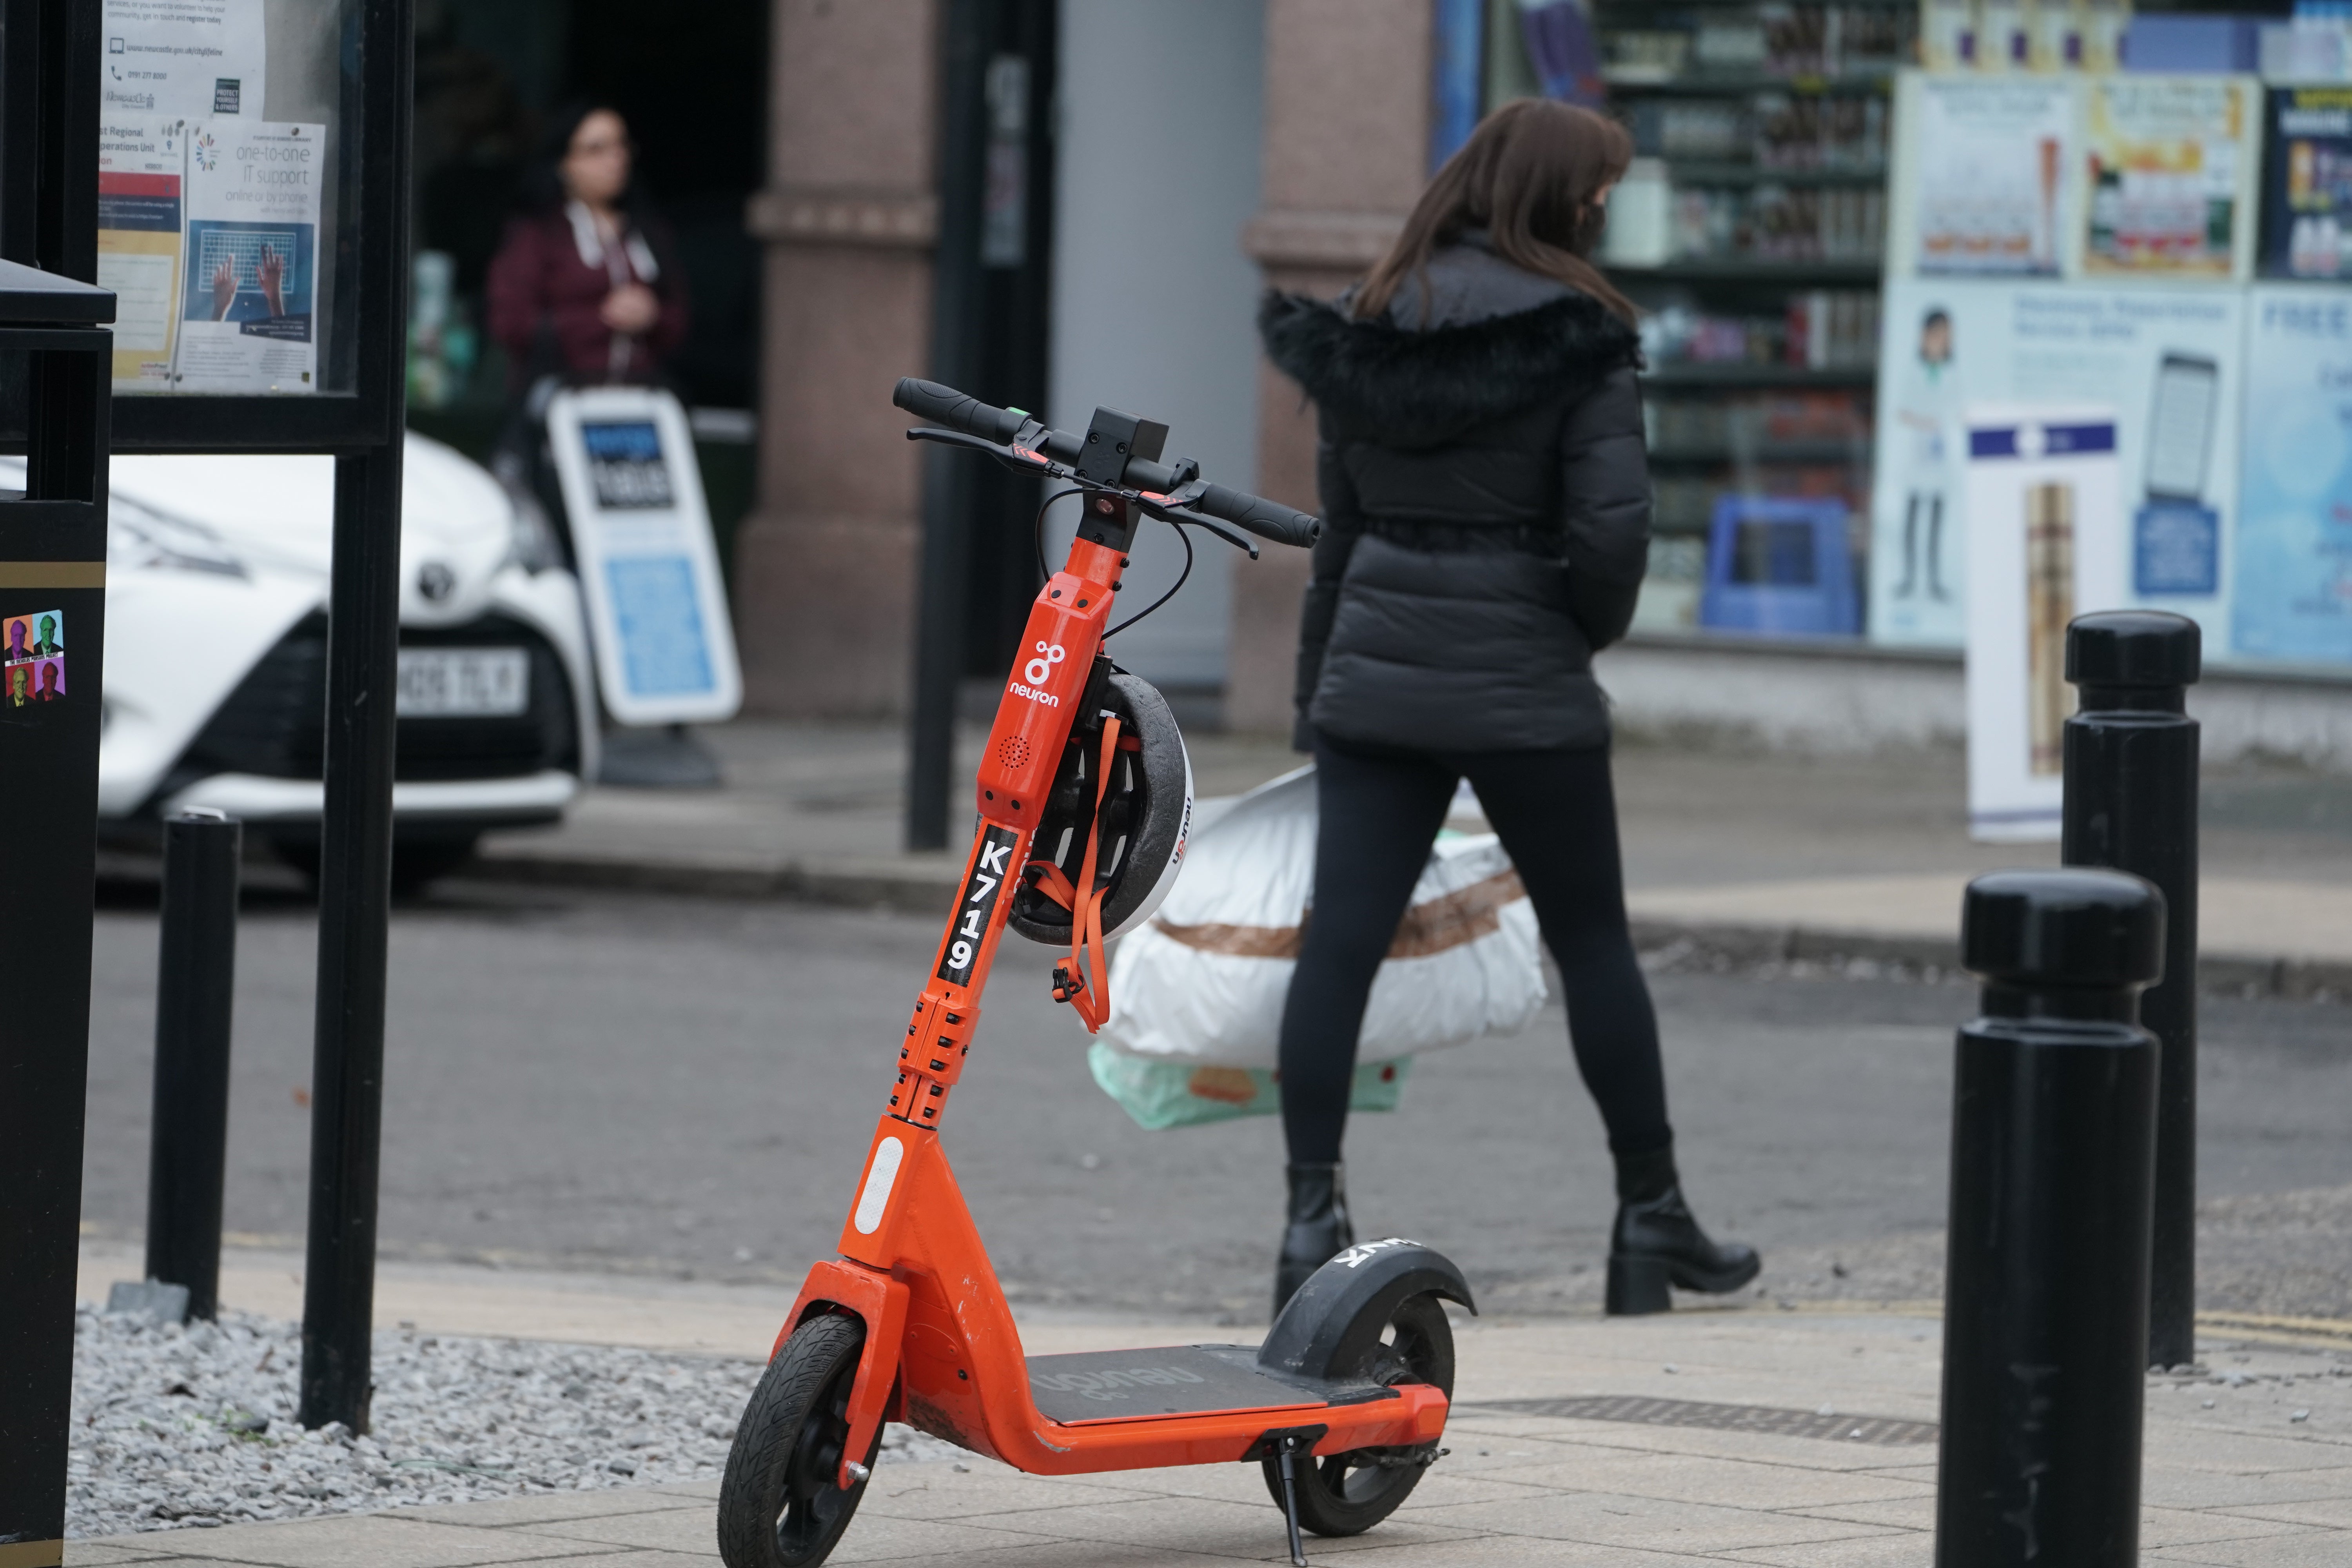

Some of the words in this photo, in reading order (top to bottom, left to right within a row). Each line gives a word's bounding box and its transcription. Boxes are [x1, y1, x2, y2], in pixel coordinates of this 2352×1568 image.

[203, 5, 213, 13] help
[207, 16, 221, 25] today
[126, 45, 223, 57] www.newcastle.gov.uk/citylifeline
[106, 91, 145, 103] Newcastle
[110, 127, 143, 138] Regional
[100, 142, 138, 152] perations
[140, 143, 155, 152] Unit
[236, 146, 310, 162] one-to-one
[244, 165, 254, 182] IT
[257, 169, 309, 188] support
[226, 189, 252, 201] online
[255, 194, 263, 202] or
[266, 191, 276, 204] by
[278, 192, 308, 204] phone
[2261, 299, 2350, 337] FREE
[1009, 682, 1059, 708] neuron
[1172, 797, 1192, 865] neuron
[947, 840, 1012, 970] K719
[1029, 1367, 1205, 1398] neuron
